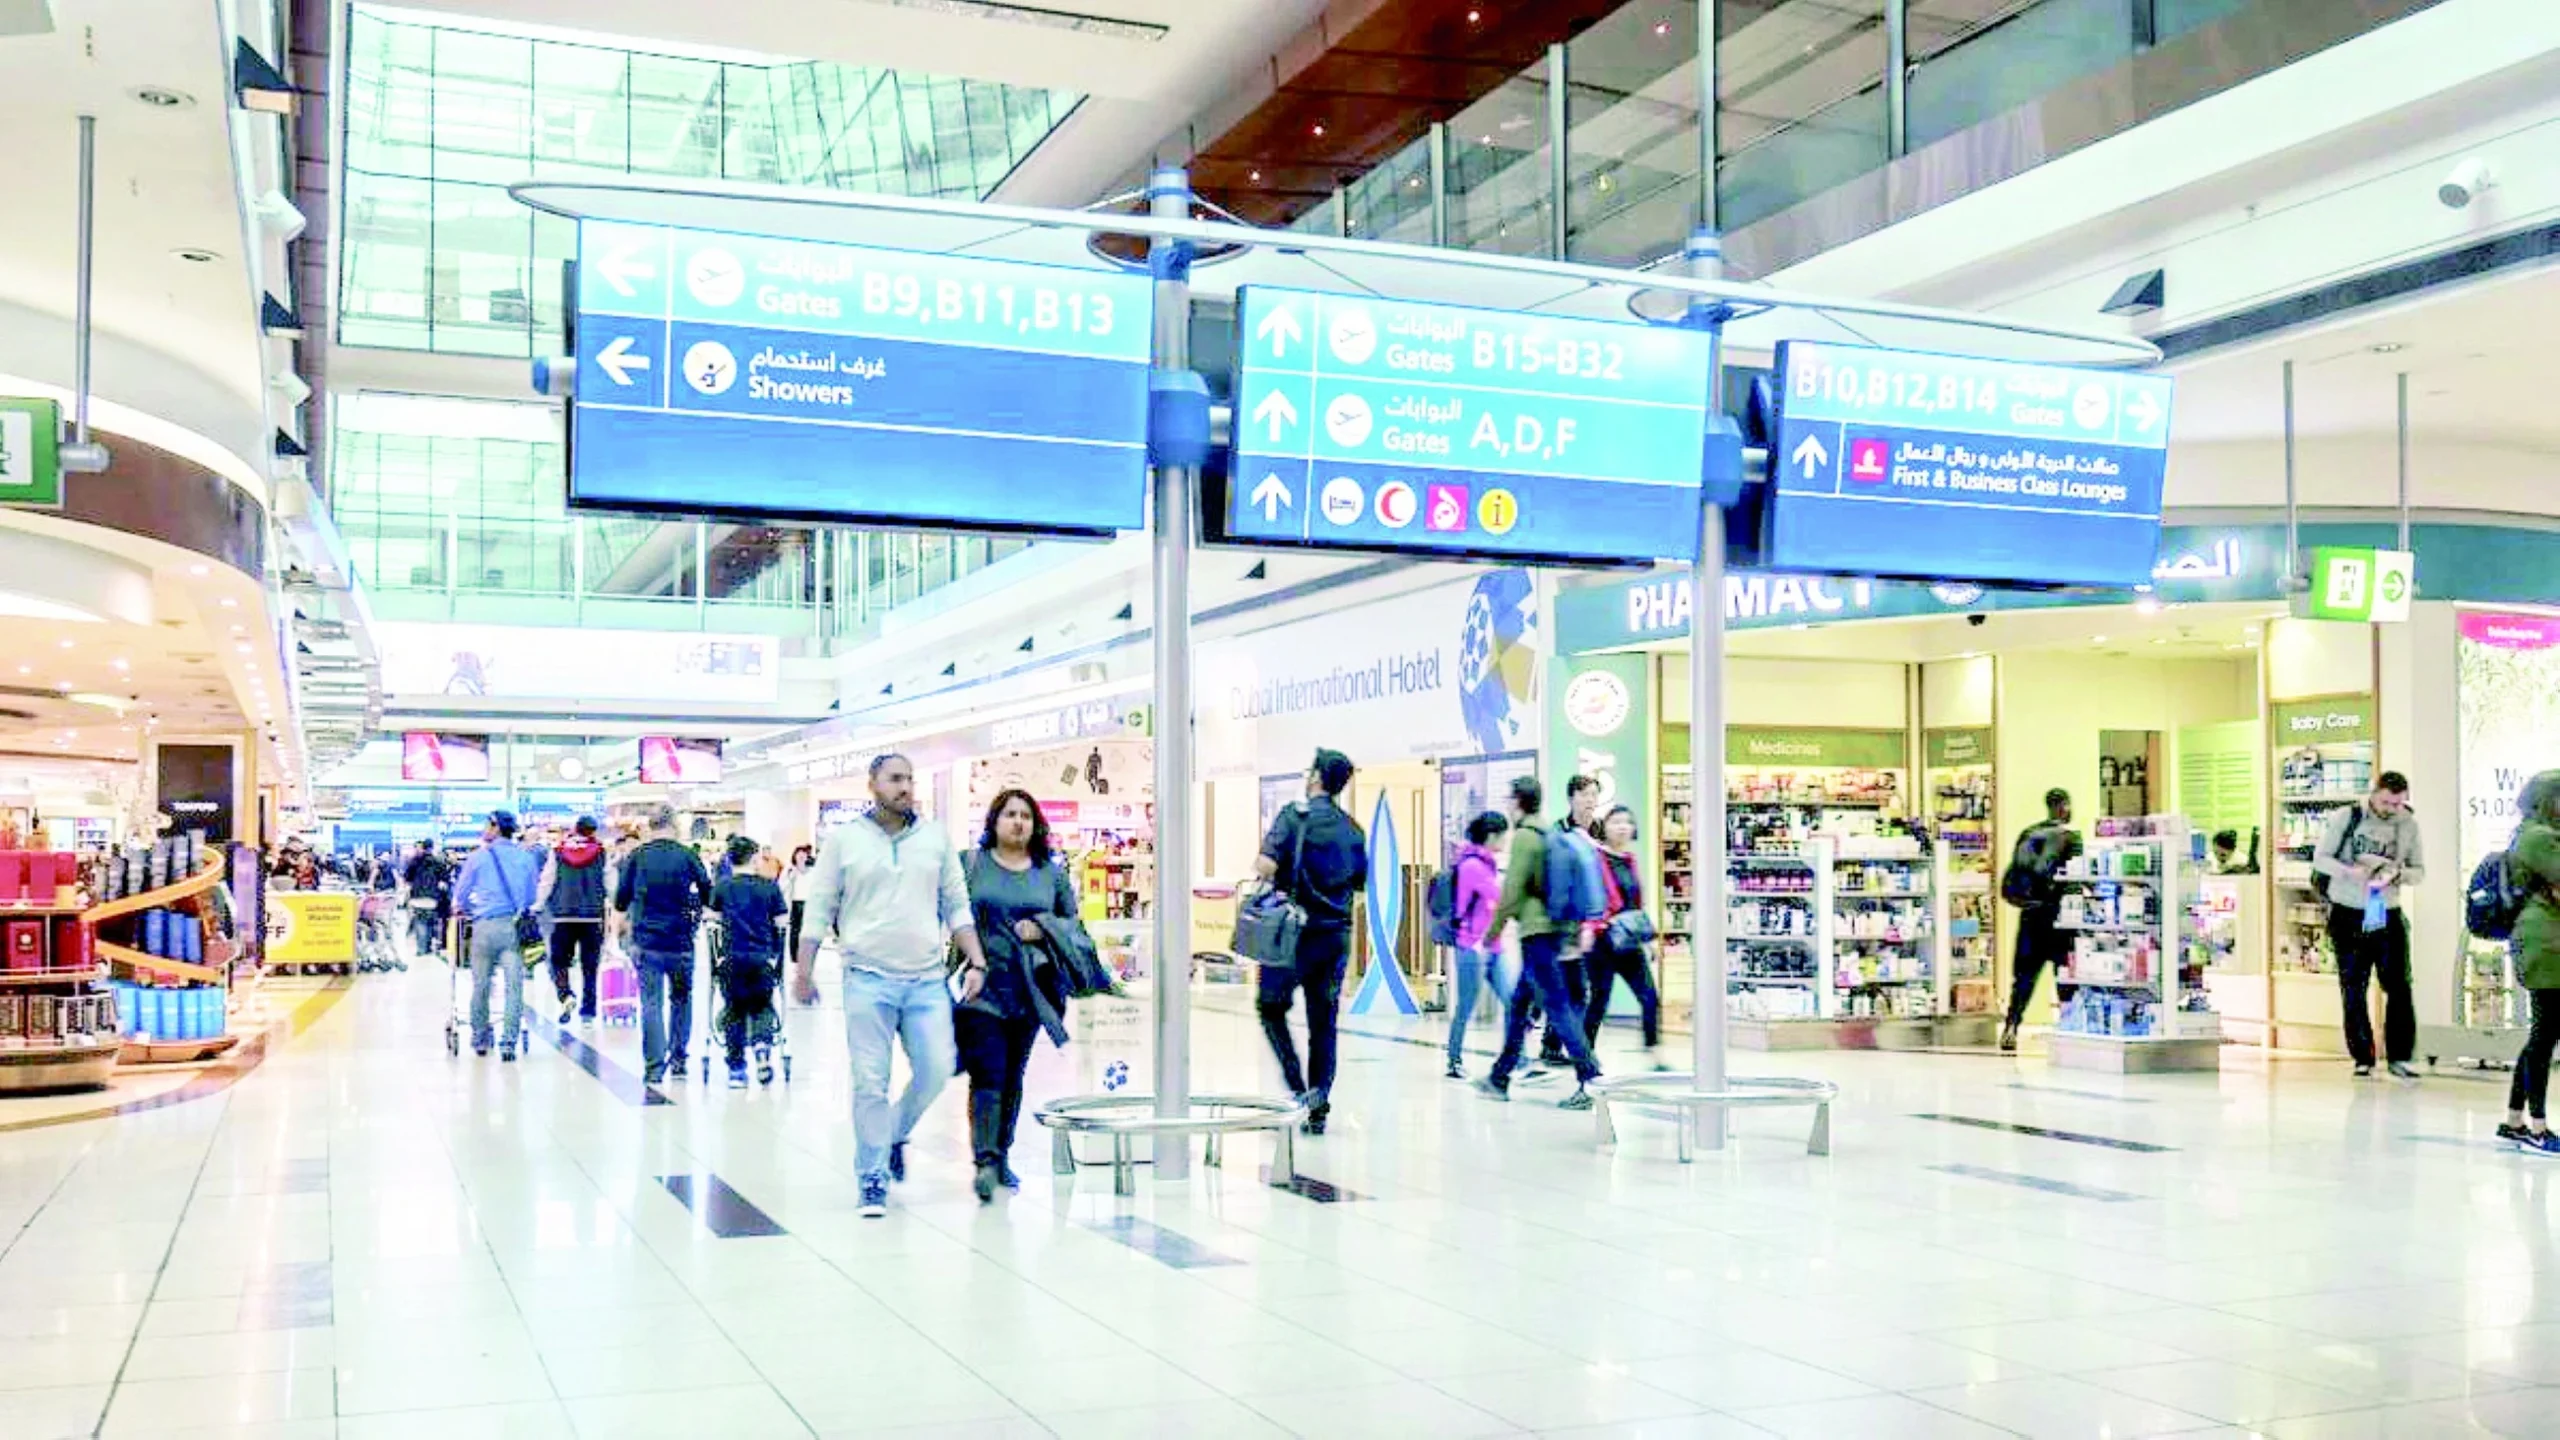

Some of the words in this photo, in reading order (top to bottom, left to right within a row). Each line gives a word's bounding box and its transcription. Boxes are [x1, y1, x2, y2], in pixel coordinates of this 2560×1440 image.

[757, 286, 841, 318] Gates
[863, 272, 1114, 335] B9,B11,B13
[1387, 314, 1466, 341] البوابات
[750, 346, 836, 375] استحمام
[841, 357, 886, 380] غرف
[1386, 344, 1454, 373] Gates
[1473, 331, 1623, 380] B15-B32
[749, 376, 853, 406] Showers
[1797, 364, 1997, 415] B10,B12,B14
[1384, 397, 1463, 423] البوابات
[2010, 402, 2065, 427] Gates
[1382, 427, 1450, 455] Gates
[1470, 411, 1577, 460] A,D,F
[1893, 466, 1930, 487] First
[1933, 468, 1947, 488] &
[1950, 469, 2017, 493] Business
[2021, 475, 2059, 496] Class
[2062, 478, 2127, 503] Lounges
[1628, 575, 1870, 632] PHAMAC
[1231, 679, 1274, 720] Dubai
[1276, 657, 1384, 714] International
[1389, 646, 1442, 697] Hotel
[2291, 715, 2322, 732] Baby
[2326, 712, 2360, 728] Care
